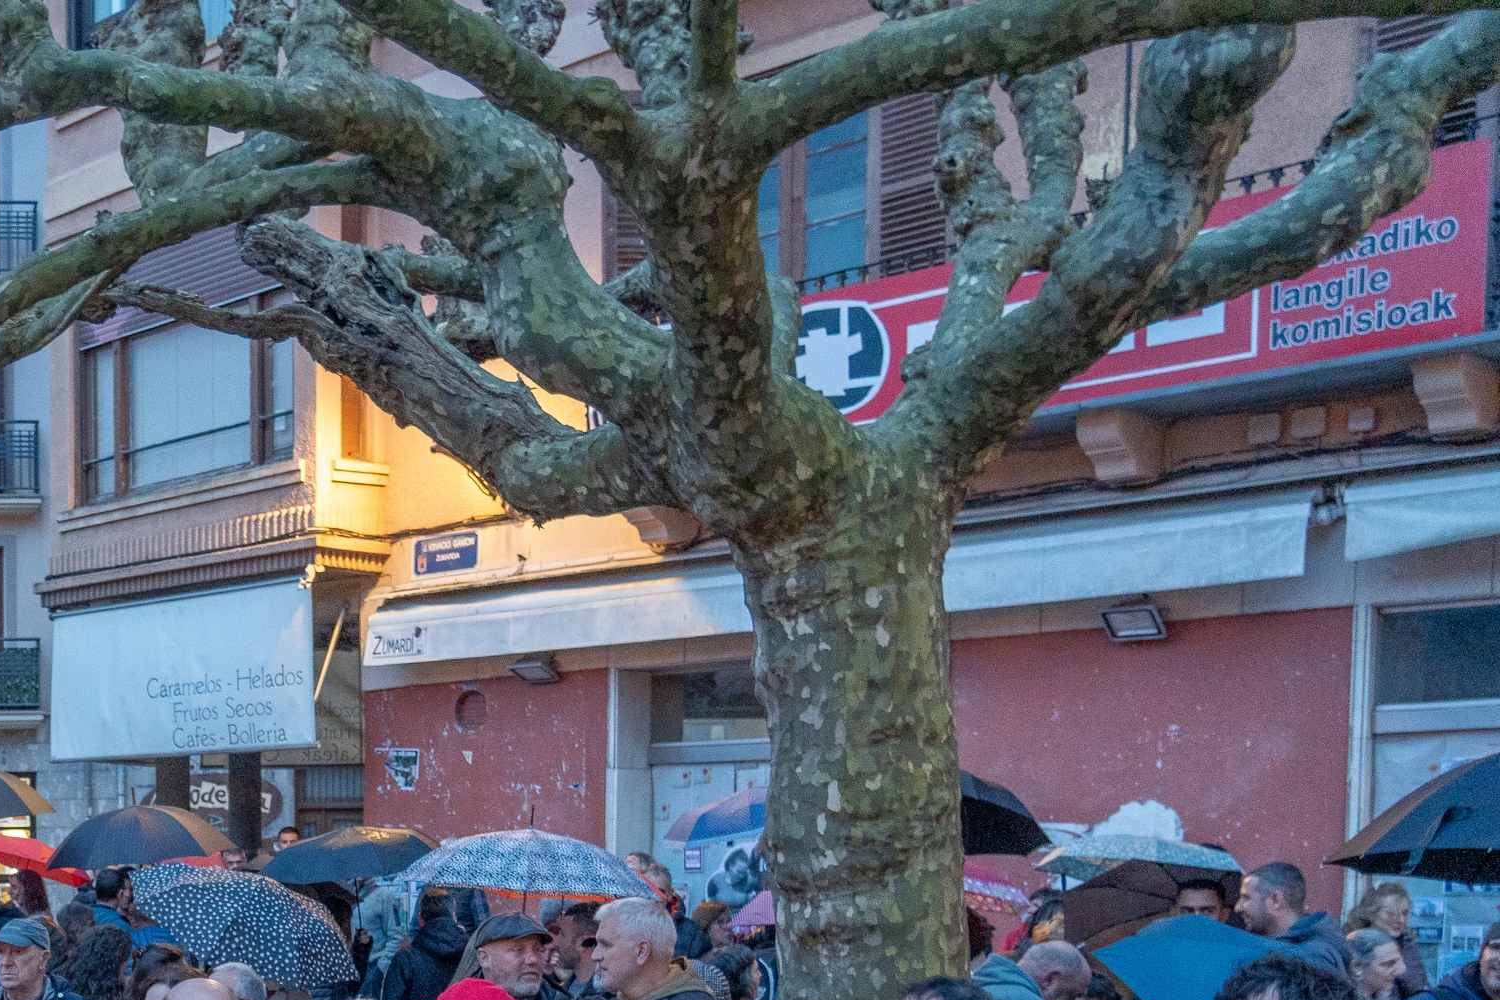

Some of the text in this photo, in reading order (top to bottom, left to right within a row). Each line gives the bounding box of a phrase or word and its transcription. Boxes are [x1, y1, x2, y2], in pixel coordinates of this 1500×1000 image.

[1318, 215, 1459, 267] adiko
[1270, 266, 1391, 314] langile
[1269, 288, 1457, 350] komisioak
[146, 673, 222, 699] Caramelos
[236, 665, 304, 691] Helados
[173, 697, 273, 724] Frutos Secos
